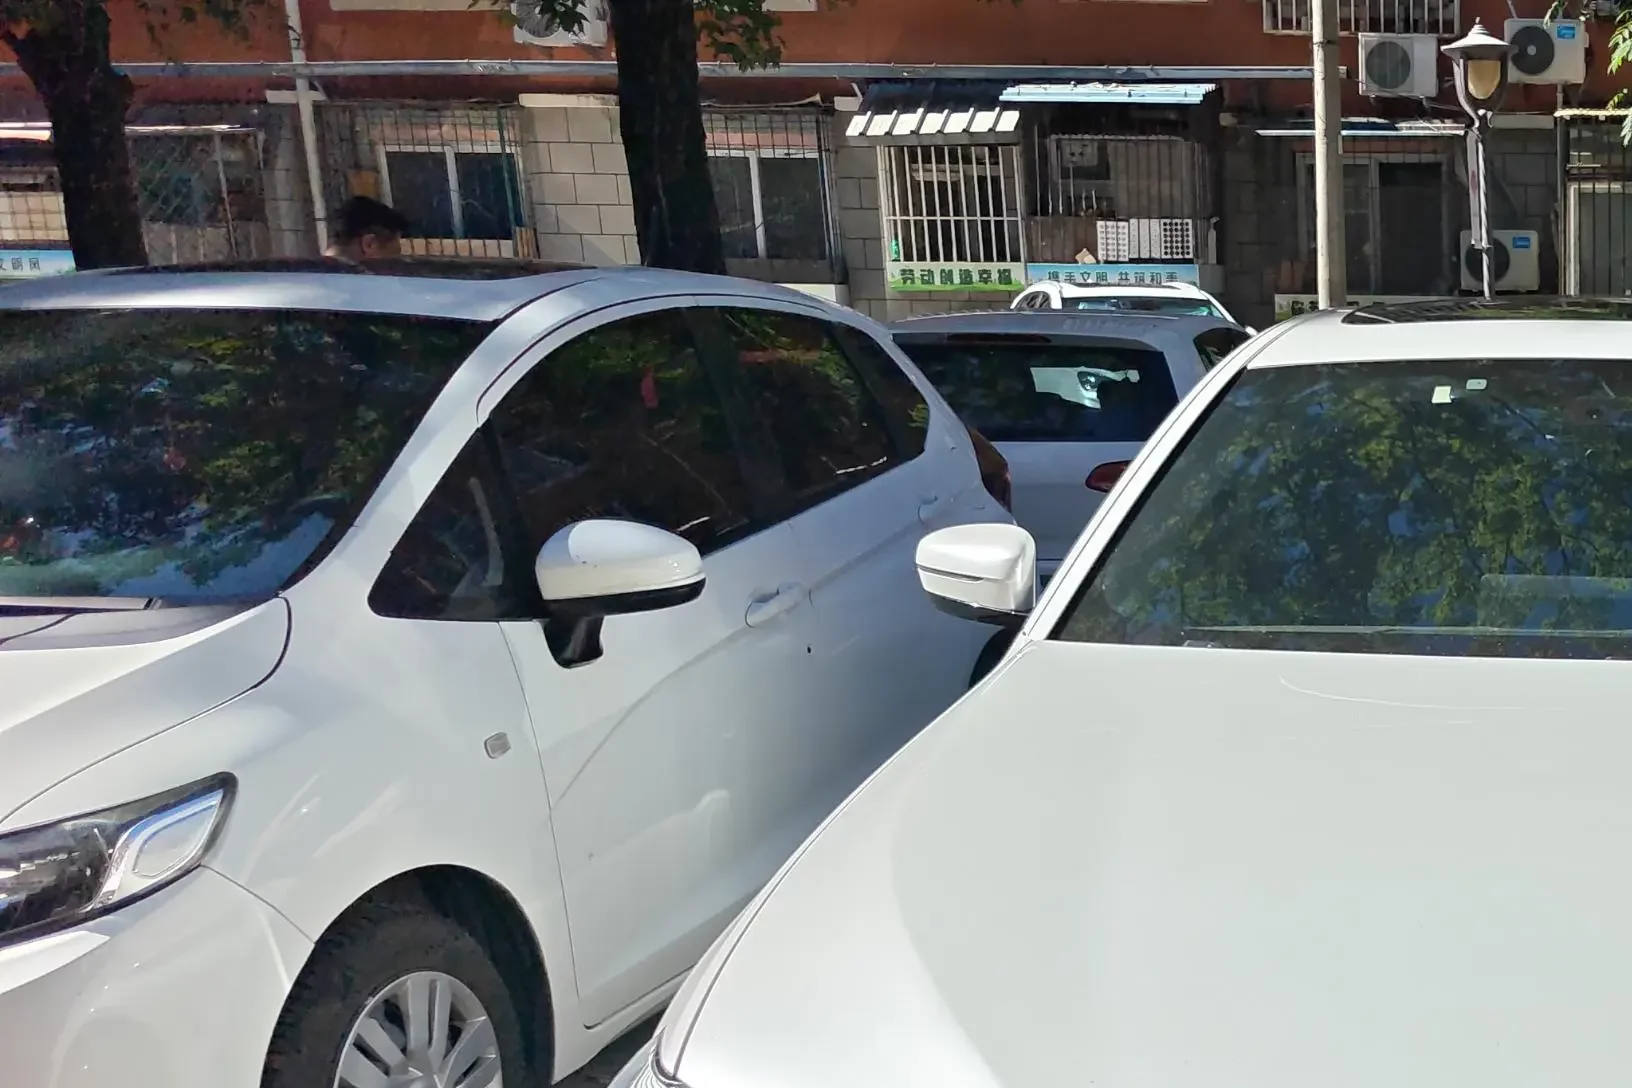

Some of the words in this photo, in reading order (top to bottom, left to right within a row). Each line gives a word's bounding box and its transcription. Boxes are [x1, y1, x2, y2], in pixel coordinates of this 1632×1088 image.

[900, 268, 1012, 285] 劳动创造幸福
